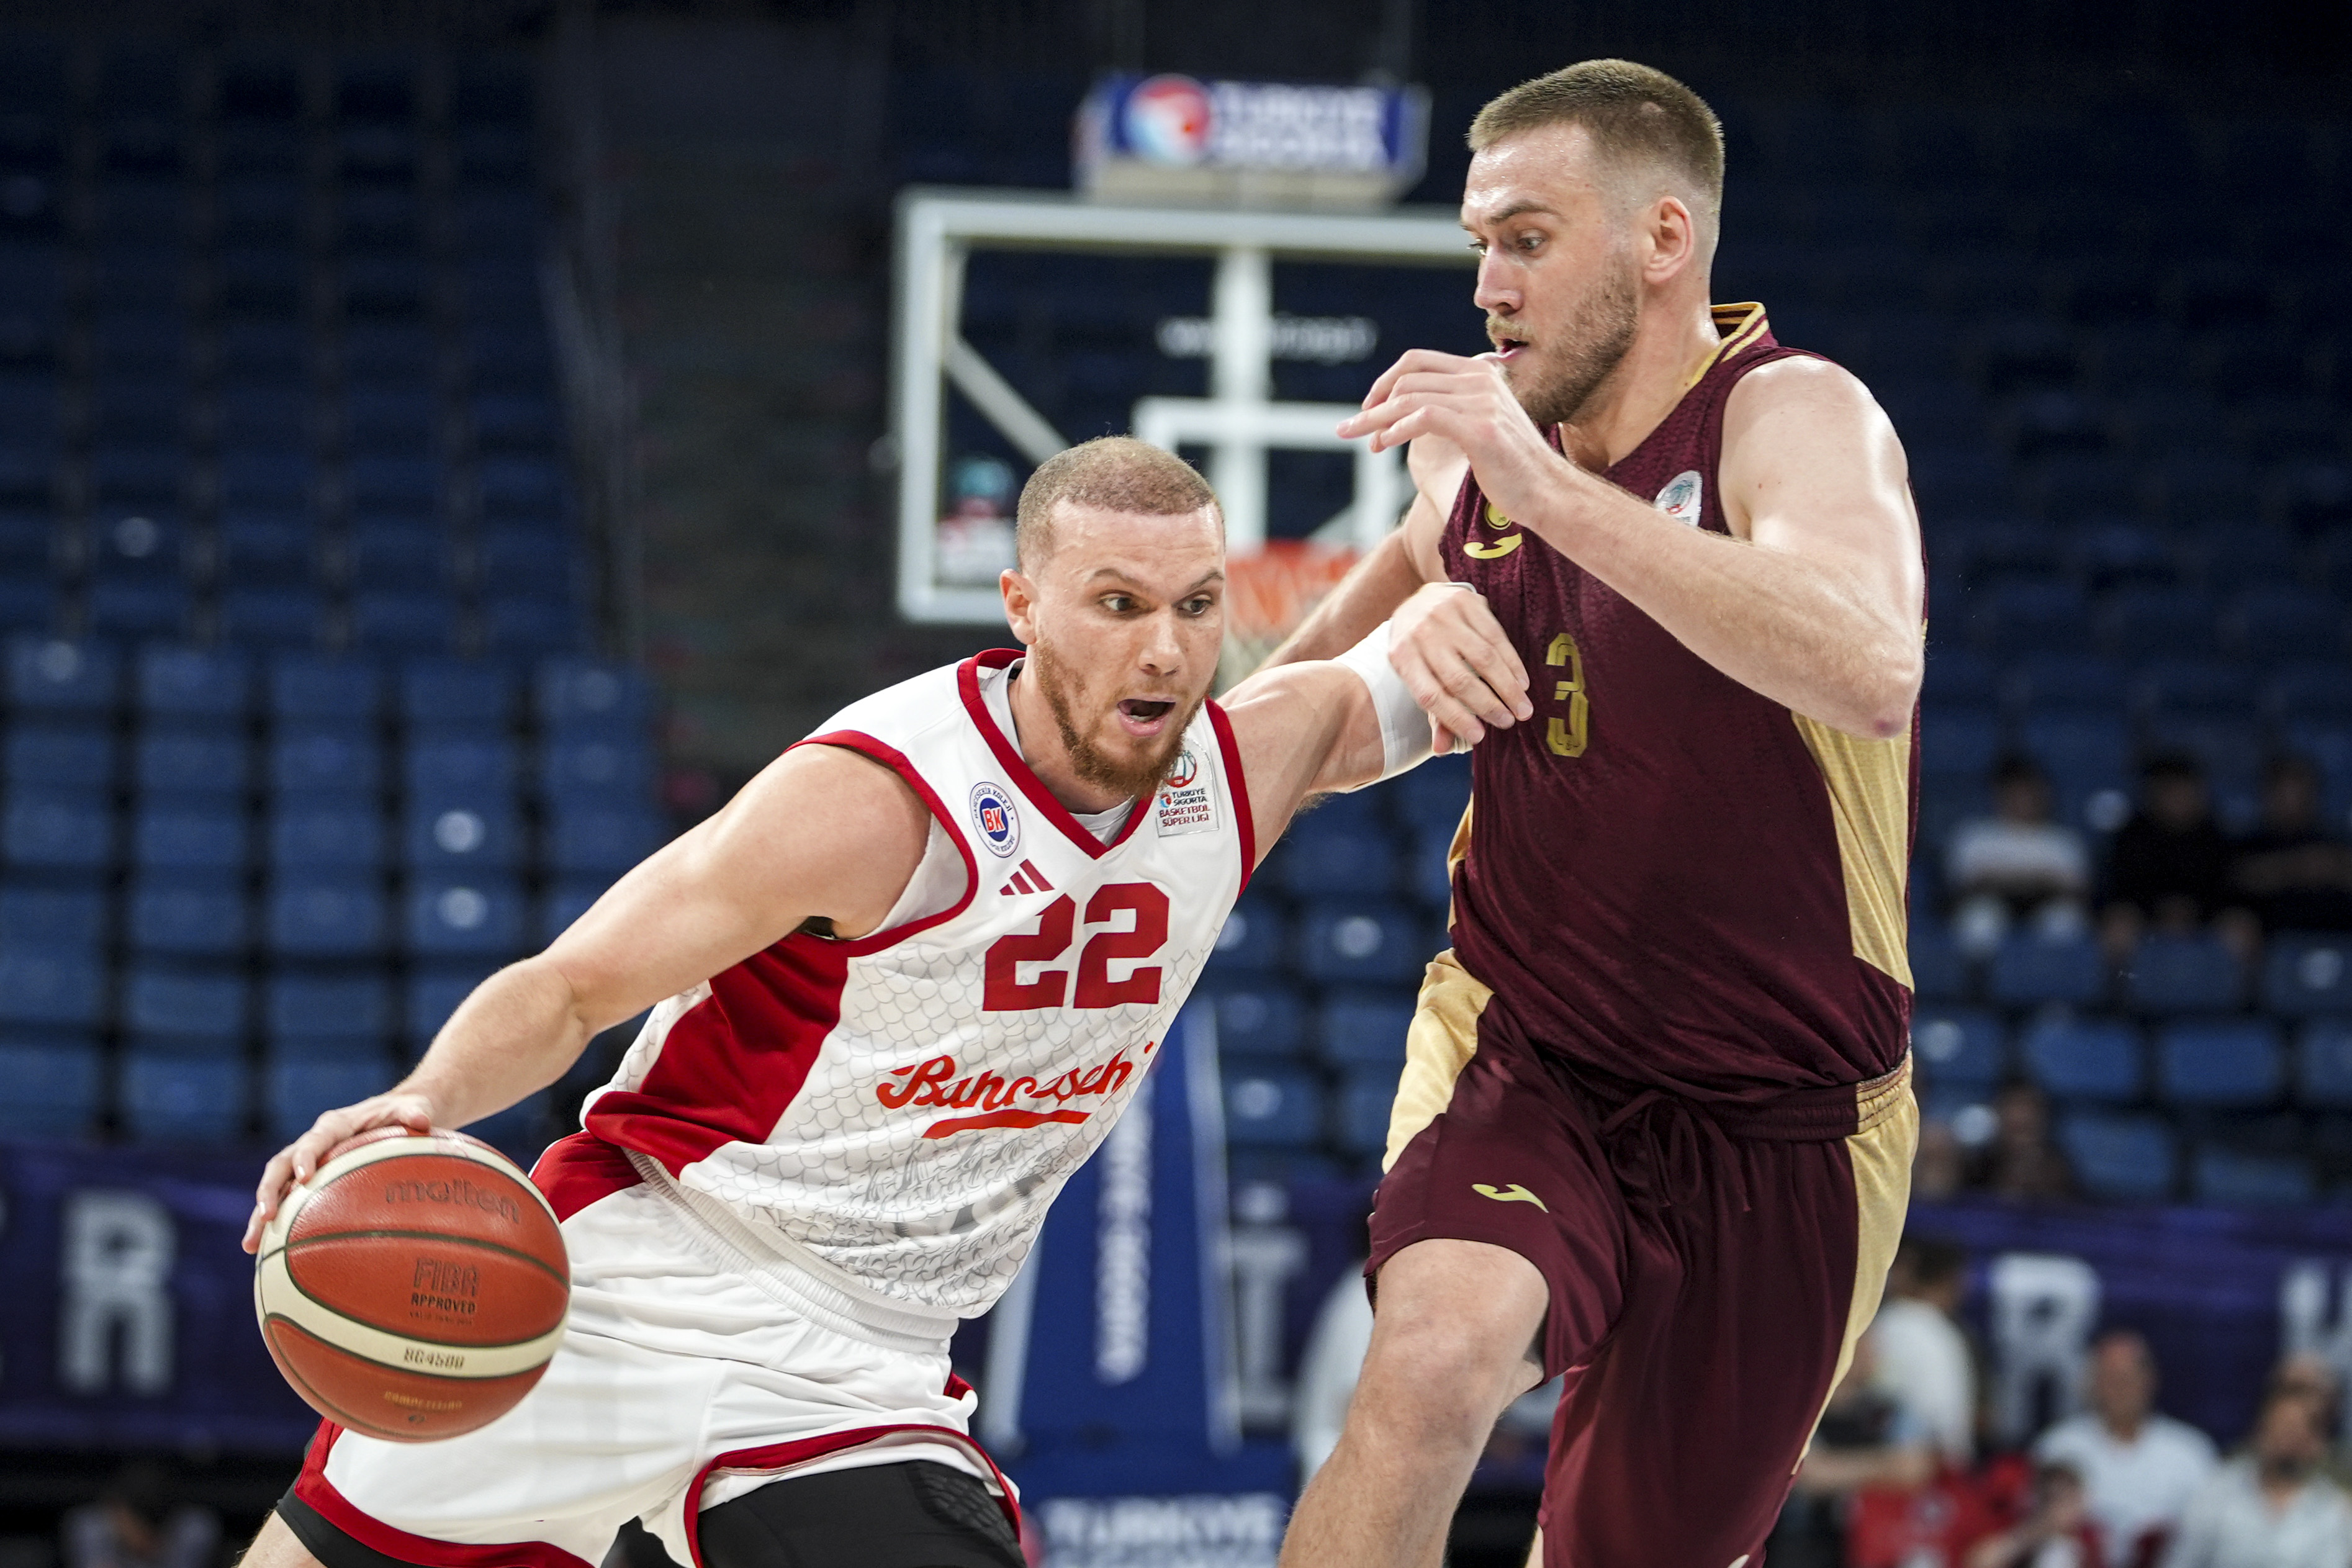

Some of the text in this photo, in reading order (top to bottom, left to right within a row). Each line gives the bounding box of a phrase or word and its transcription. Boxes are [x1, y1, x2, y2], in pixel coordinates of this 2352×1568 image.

[1546, 633, 1589, 758] 3
[982, 807, 1006, 832] BK
[982, 883, 1169, 1011] 22
[385, 1178, 520, 1225] molten
[414, 1258, 477, 1297] FIBA
[412, 1292, 476, 1315] APPROVED
